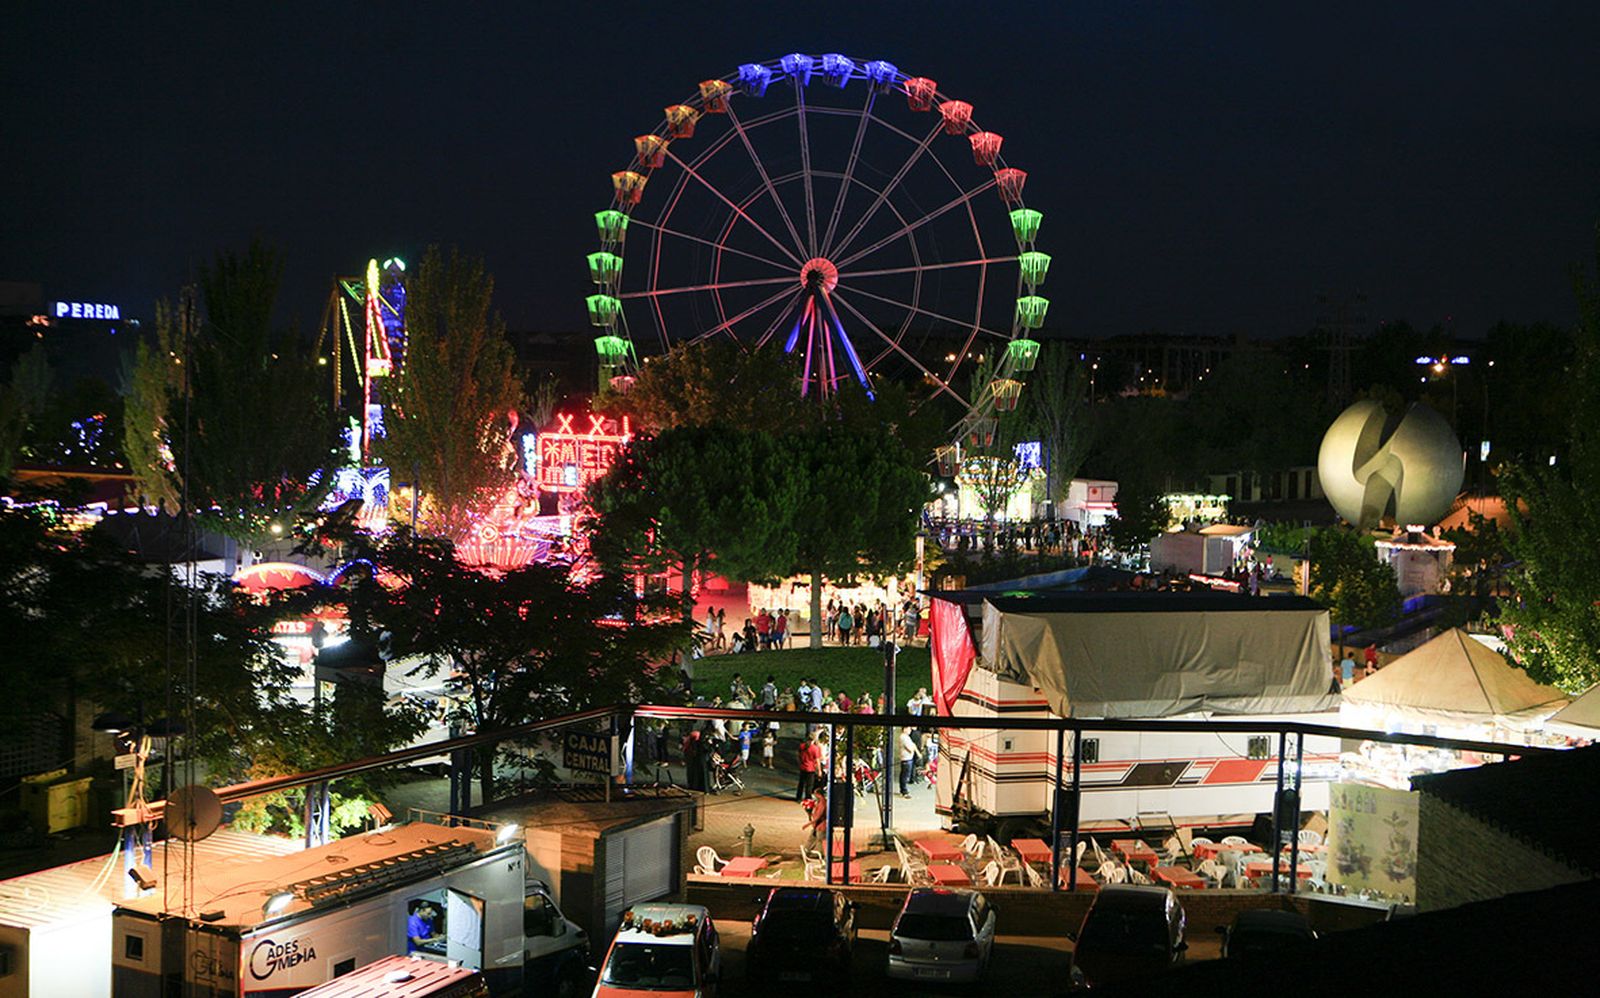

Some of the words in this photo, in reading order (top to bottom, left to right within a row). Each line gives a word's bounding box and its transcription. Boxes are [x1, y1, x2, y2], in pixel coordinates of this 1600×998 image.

[56, 302, 119, 319] PEREDA
[568, 734, 608, 753] CAJA
[566, 751, 610, 773] CENTRAL
